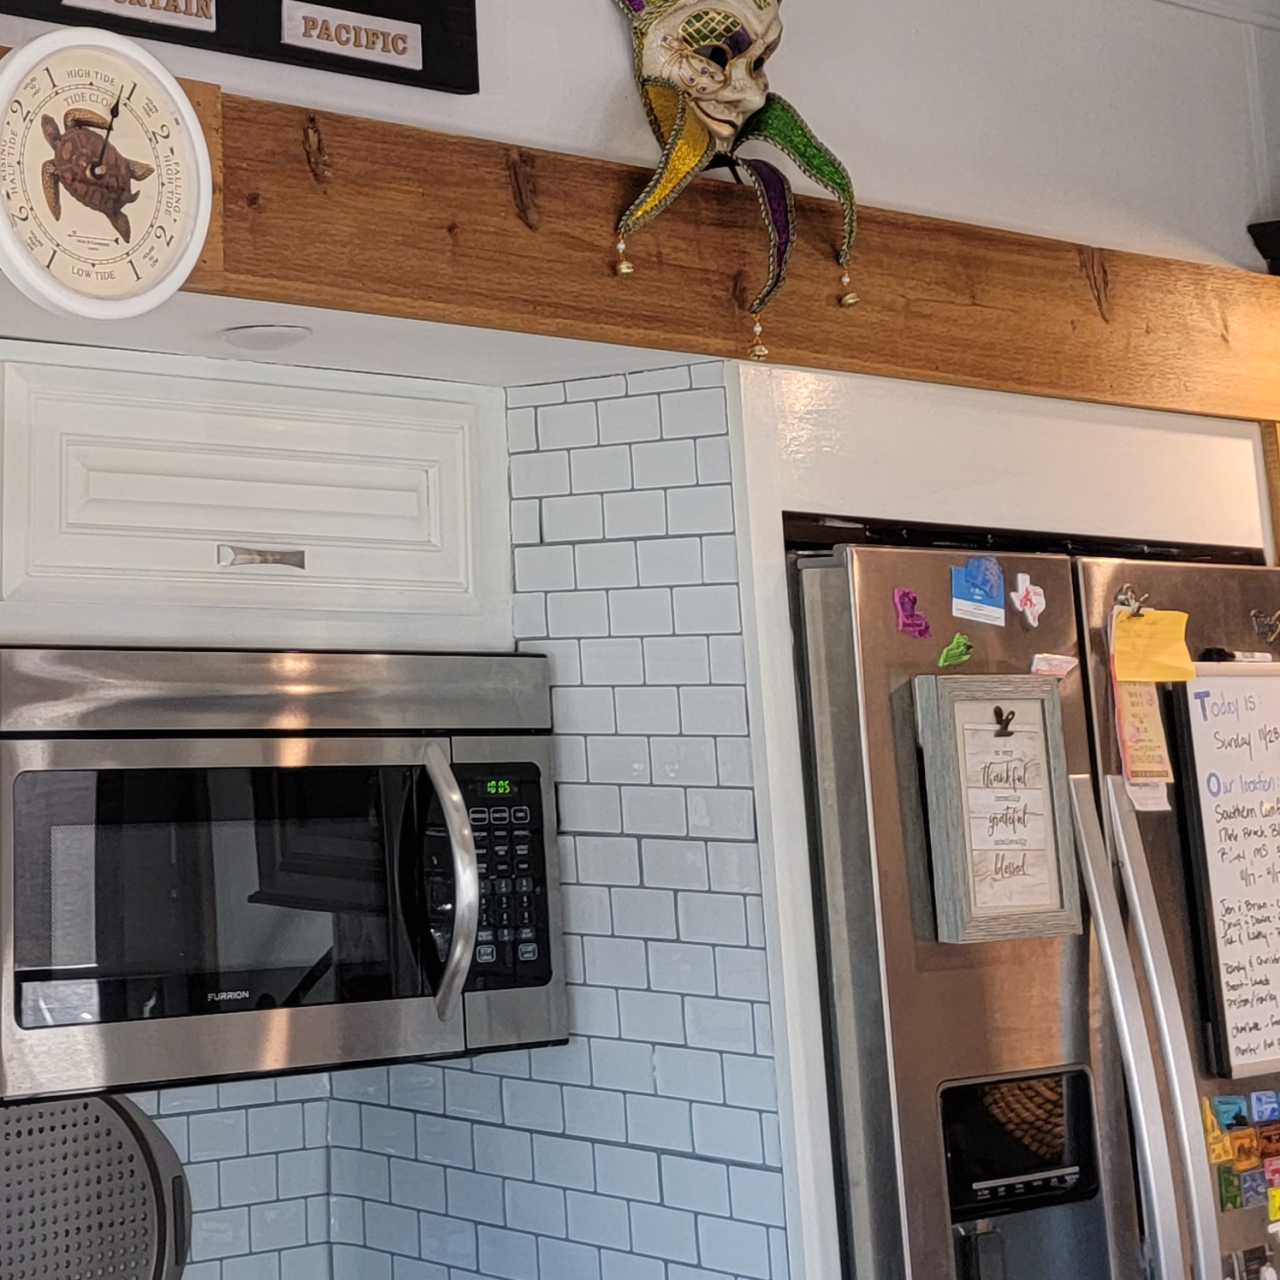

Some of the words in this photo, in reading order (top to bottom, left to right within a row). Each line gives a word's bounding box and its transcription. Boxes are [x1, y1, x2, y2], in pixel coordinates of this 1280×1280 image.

[301, 15, 409, 56] PACIFIC
[42, 66, 59, 89] 1
[66, 68, 91, 79] HIGH
[93, 70, 116, 87] TIDE
[63, 92, 87, 107] TIDE
[88, 92, 112, 108] CLO
[124, 80, 137, 103] 1
[10, 99, 31, 123] 2
[7, 128, 19, 157] TIDE
[151, 123, 171, 145] 2
[173, 161, 182, 214] FALLING
[10, 205, 29, 228] 2
[154, 225, 174, 248] 2
[44, 247, 57, 270] 1
[126, 258, 143, 282] 1
[71, 265, 92, 279] LOW
[94, 270, 116, 280] TIDE
[1193, 690, 1240, 722] Today
[1213, 730, 1253, 761] Sunday
[980, 760, 1028, 793] thankful
[1207, 772, 1235, 798] Our
[988, 803, 1028, 837] grateful
[995, 853, 1027, 879] blessed
[207, 990, 250, 1002] FURRION
